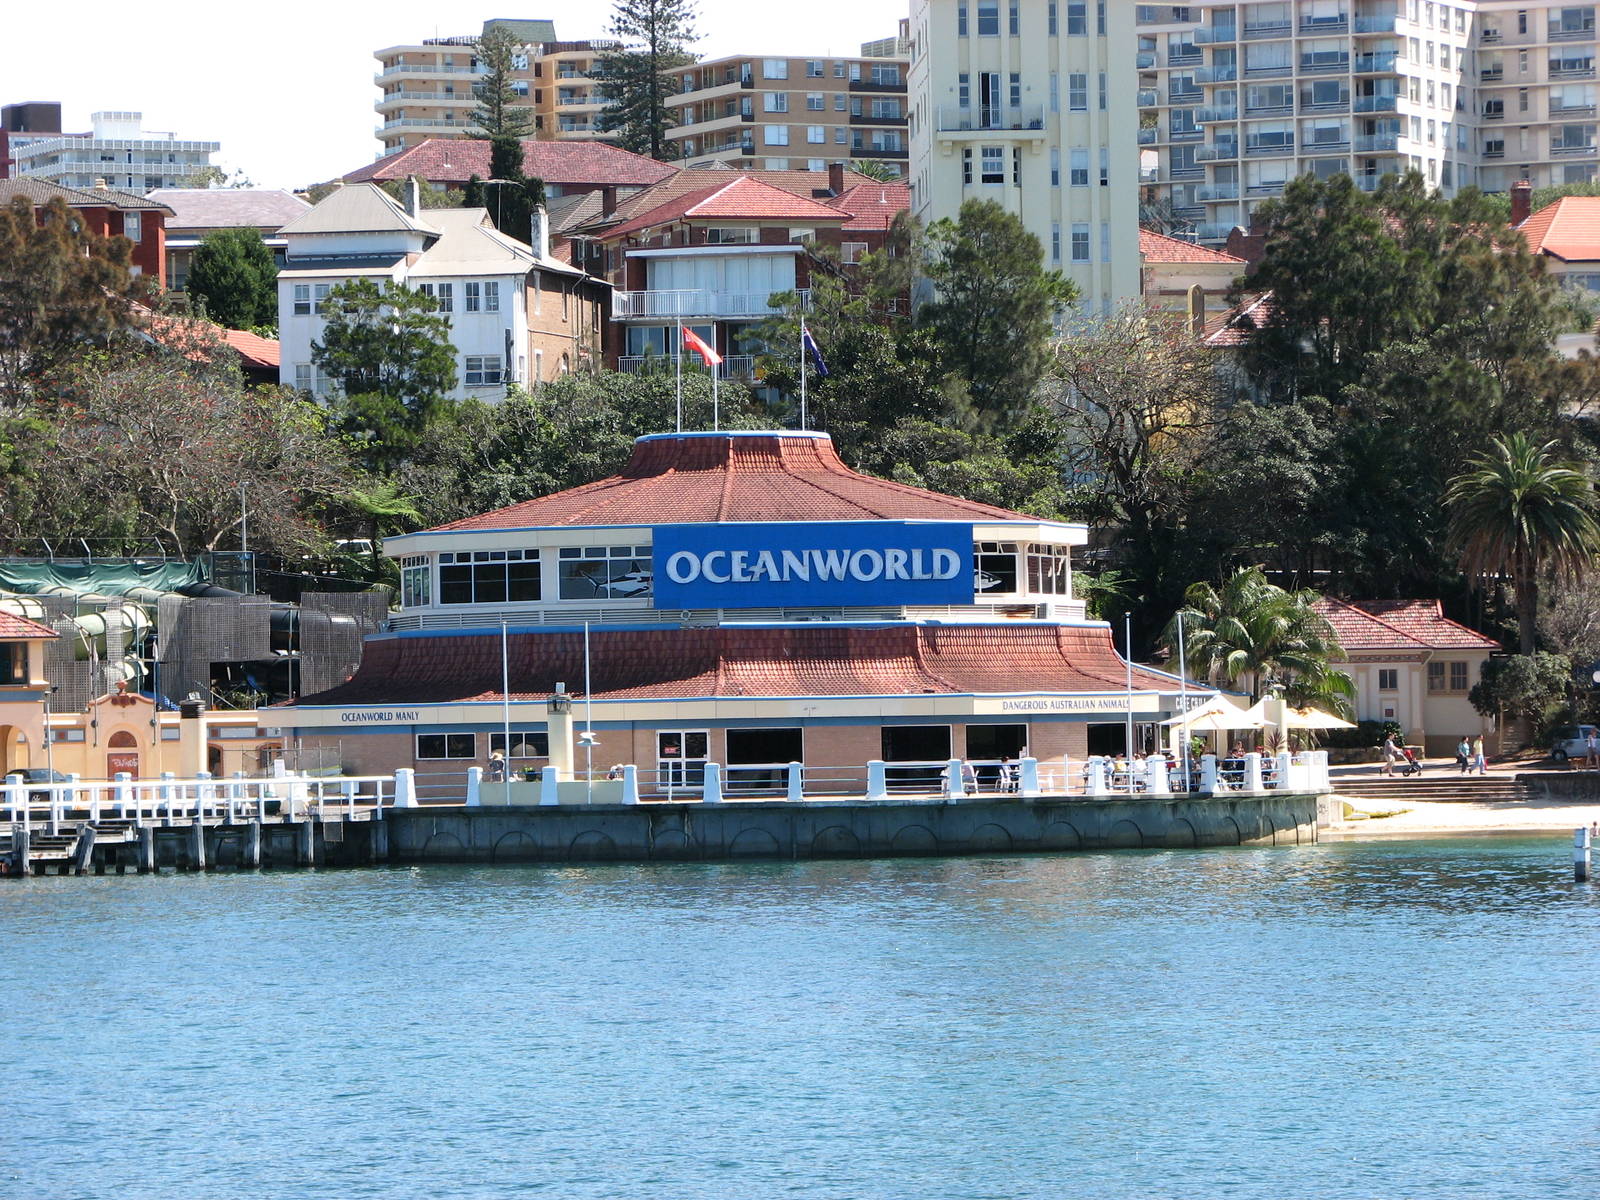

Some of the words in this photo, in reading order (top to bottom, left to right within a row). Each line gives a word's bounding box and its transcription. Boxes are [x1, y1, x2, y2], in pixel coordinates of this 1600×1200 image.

[666, 549, 961, 584] OCEANWORLD
[1002, 701, 1048, 711] DANGEROUS
[1050, 700, 1096, 710] AUSTRALIAN
[341, 712, 393, 722] OCEANWORLD
[395, 711, 420, 721] MANLY
